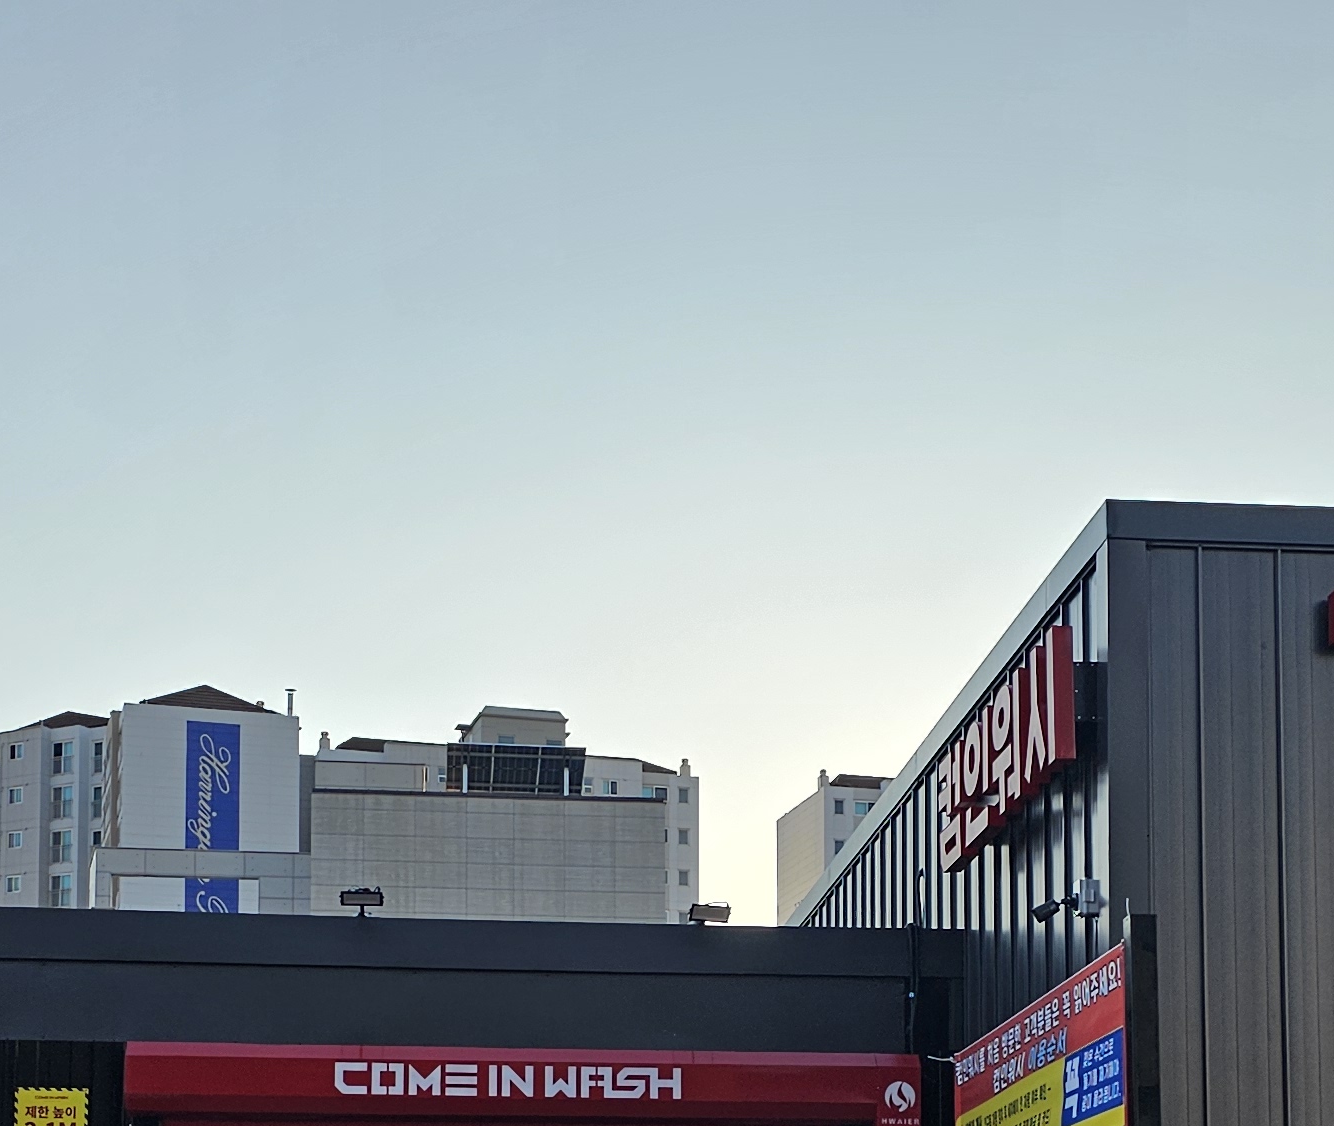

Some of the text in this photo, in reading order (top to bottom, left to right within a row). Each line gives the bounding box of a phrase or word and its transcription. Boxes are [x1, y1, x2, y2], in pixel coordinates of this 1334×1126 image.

[938, 626, 1067, 873] 컴인워시
[188, 733, 232, 885] Harring
[955, 957, 1122, 1086] 컴인워시를 처음 방문한 고객분들은 꼭 읽어주세요!
[334, 1061, 683, 1100] COME IN WASH
[993, 1026, 1068, 1094] 컴인워시 이용순서
[25, 1106, 76, 1119] 제한 높이
[881, 1118, 920, 1126] HWAIER
